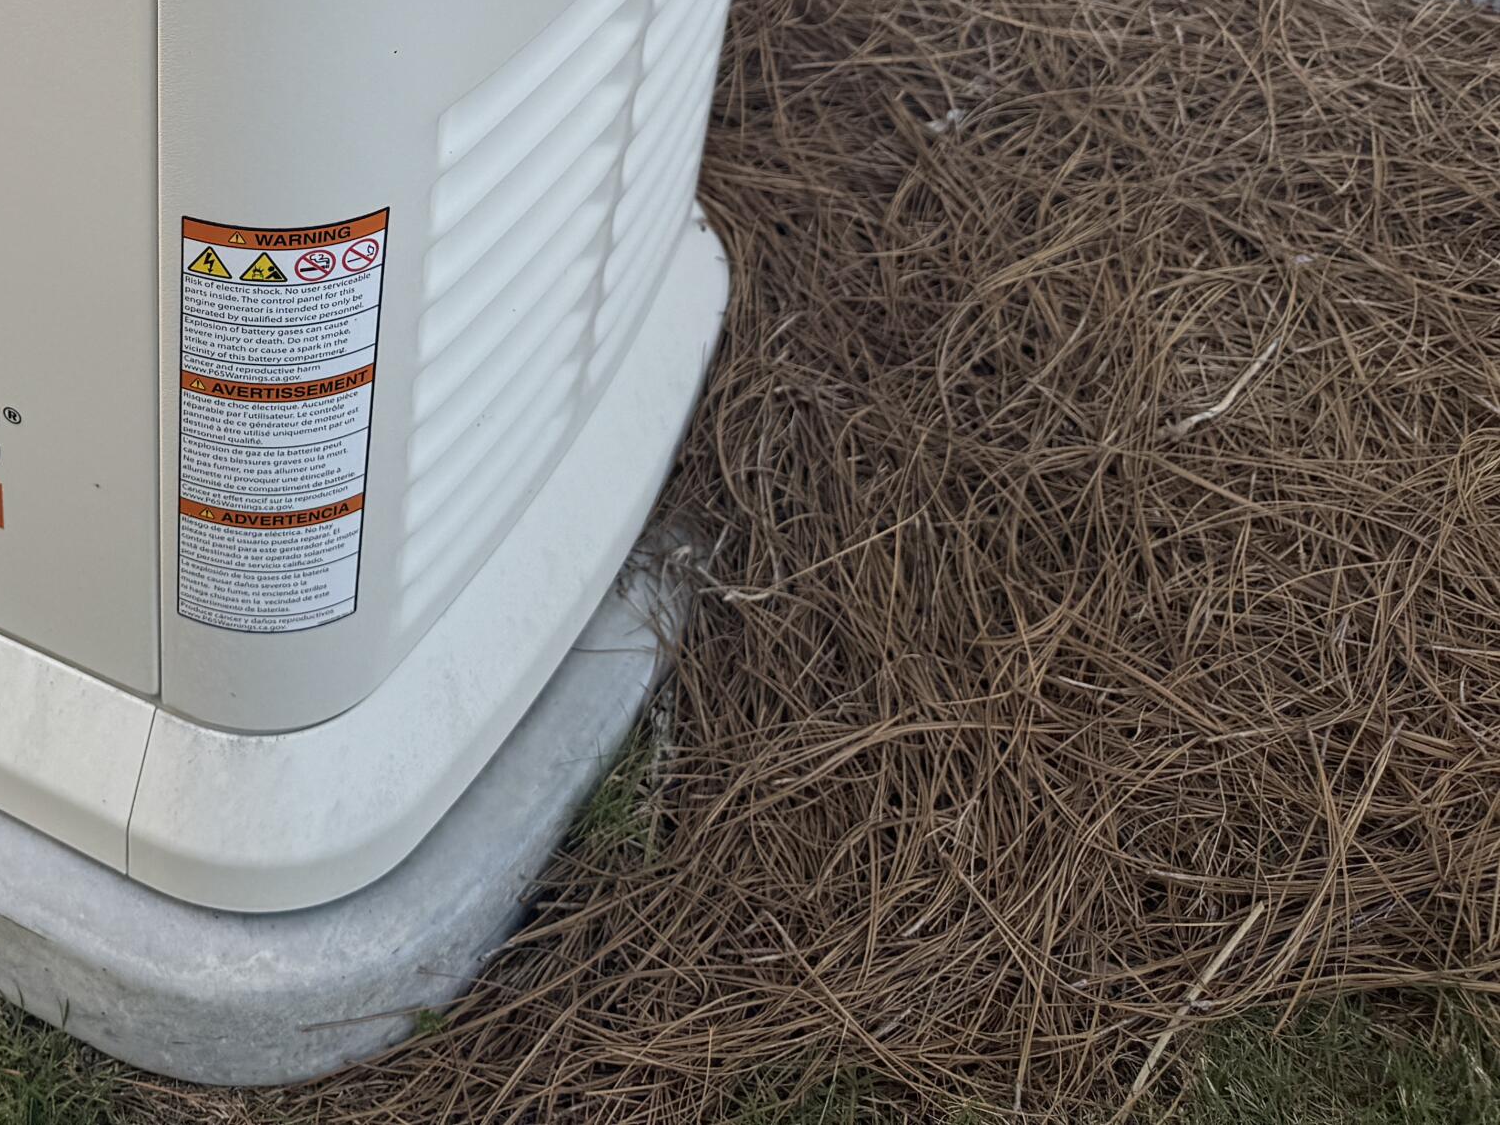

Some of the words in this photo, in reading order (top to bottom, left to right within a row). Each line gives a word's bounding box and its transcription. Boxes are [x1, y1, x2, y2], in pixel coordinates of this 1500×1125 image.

[255, 226, 352, 247] WARNING
[185, 275, 202, 286] Risk
[204, 280, 215, 288] of
[216, 283, 251, 293] electric
[252, 287, 283, 295] shock.
[322, 271, 371, 290] serviceable
[185, 285, 207, 298] parts
[210, 291, 239, 302] inside.
[241, 296, 259, 304] The
[297, 293, 323, 305] panel
[325, 290, 338, 299] for
[339, 286, 355, 296] this
[185, 294, 216, 309] engine
[218, 302, 264, 315] generator
[276, 304, 318, 313] intended
[320, 301, 329, 309] to
[331, 296, 351, 309] only
[352, 292, 363, 302] be
[184, 303, 225, 320] operated
[227, 312, 238, 322] by
[241, 314, 282, 324] qualified
[285, 313, 317, 322] service
[319, 301, 364, 320] personnel.
[184, 316, 228, 333] Explosion
[230, 325, 240, 333] of
[242, 327, 275, 337] battery
[278, 329, 303, 337] gases
[323, 320, 349, 331] cause
[184, 326, 213, 338] severe
[215, 332, 241, 344] injury
[303, 334, 319, 343] not
[184, 343, 215, 358] vicinity
[217, 350, 227, 358] of
[229, 352, 246, 361] this
[248, 355, 282, 364] battery
[185, 334, 207, 346] strike
[217, 341, 247, 352] match
[297, 343, 321, 354] spark
[323, 341, 332, 349] in
[332, 336, 348, 347] the
[184, 354, 215, 368] Cancer
[217, 362, 233, 371] and
[235, 365, 295, 375] reproductive
[297, 363, 321, 373] harm
[211, 369, 369, 400] AVERTISSEMENT
[221, 503, 350, 527] ADVERTENCIA
